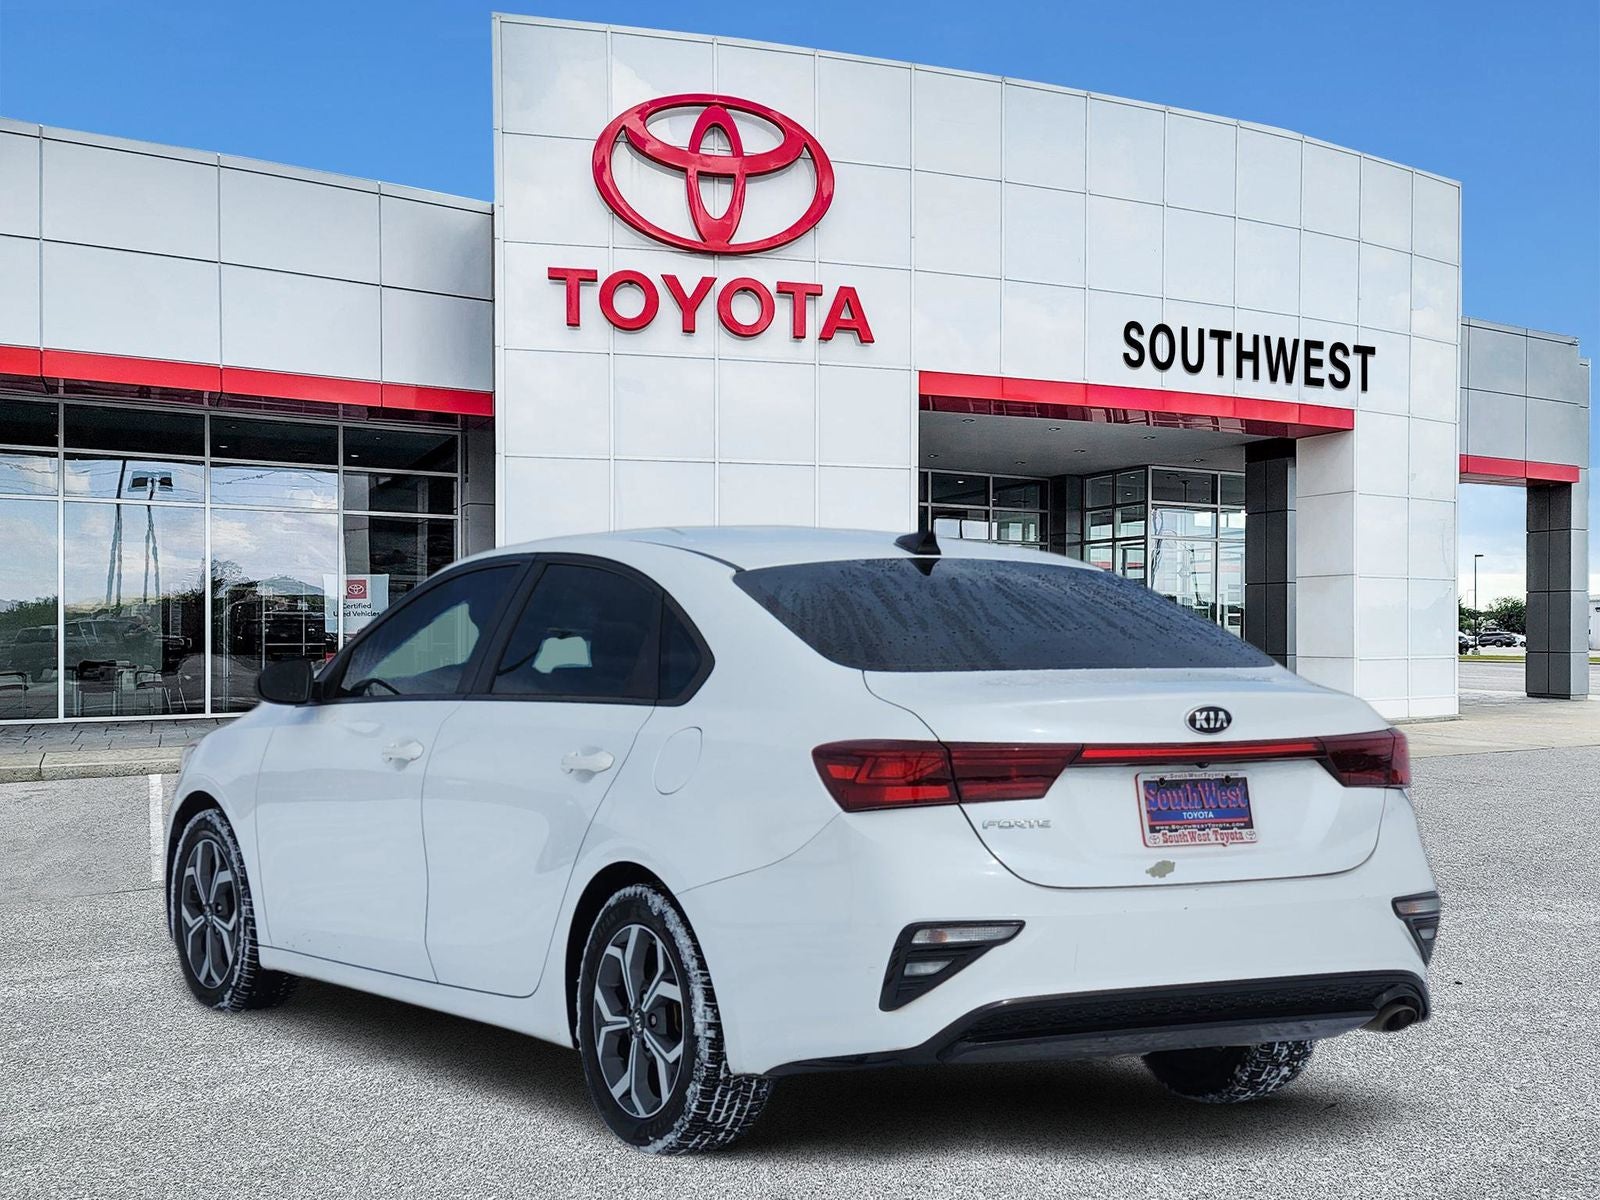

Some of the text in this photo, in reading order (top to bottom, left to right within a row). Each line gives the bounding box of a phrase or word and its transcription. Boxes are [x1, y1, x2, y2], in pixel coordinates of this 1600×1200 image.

[547, 266, 875, 344] TOYOTA
[1122, 320, 1376, 392] SOUTHWEST
[1194, 711, 1228, 729] KIA
[1144, 781, 1247, 811] SouthWest
[982, 818, 1051, 830] FORTE
[1182, 811, 1214, 820] TOYOTA
[1161, 828, 1244, 844] SouthWest Toyota
